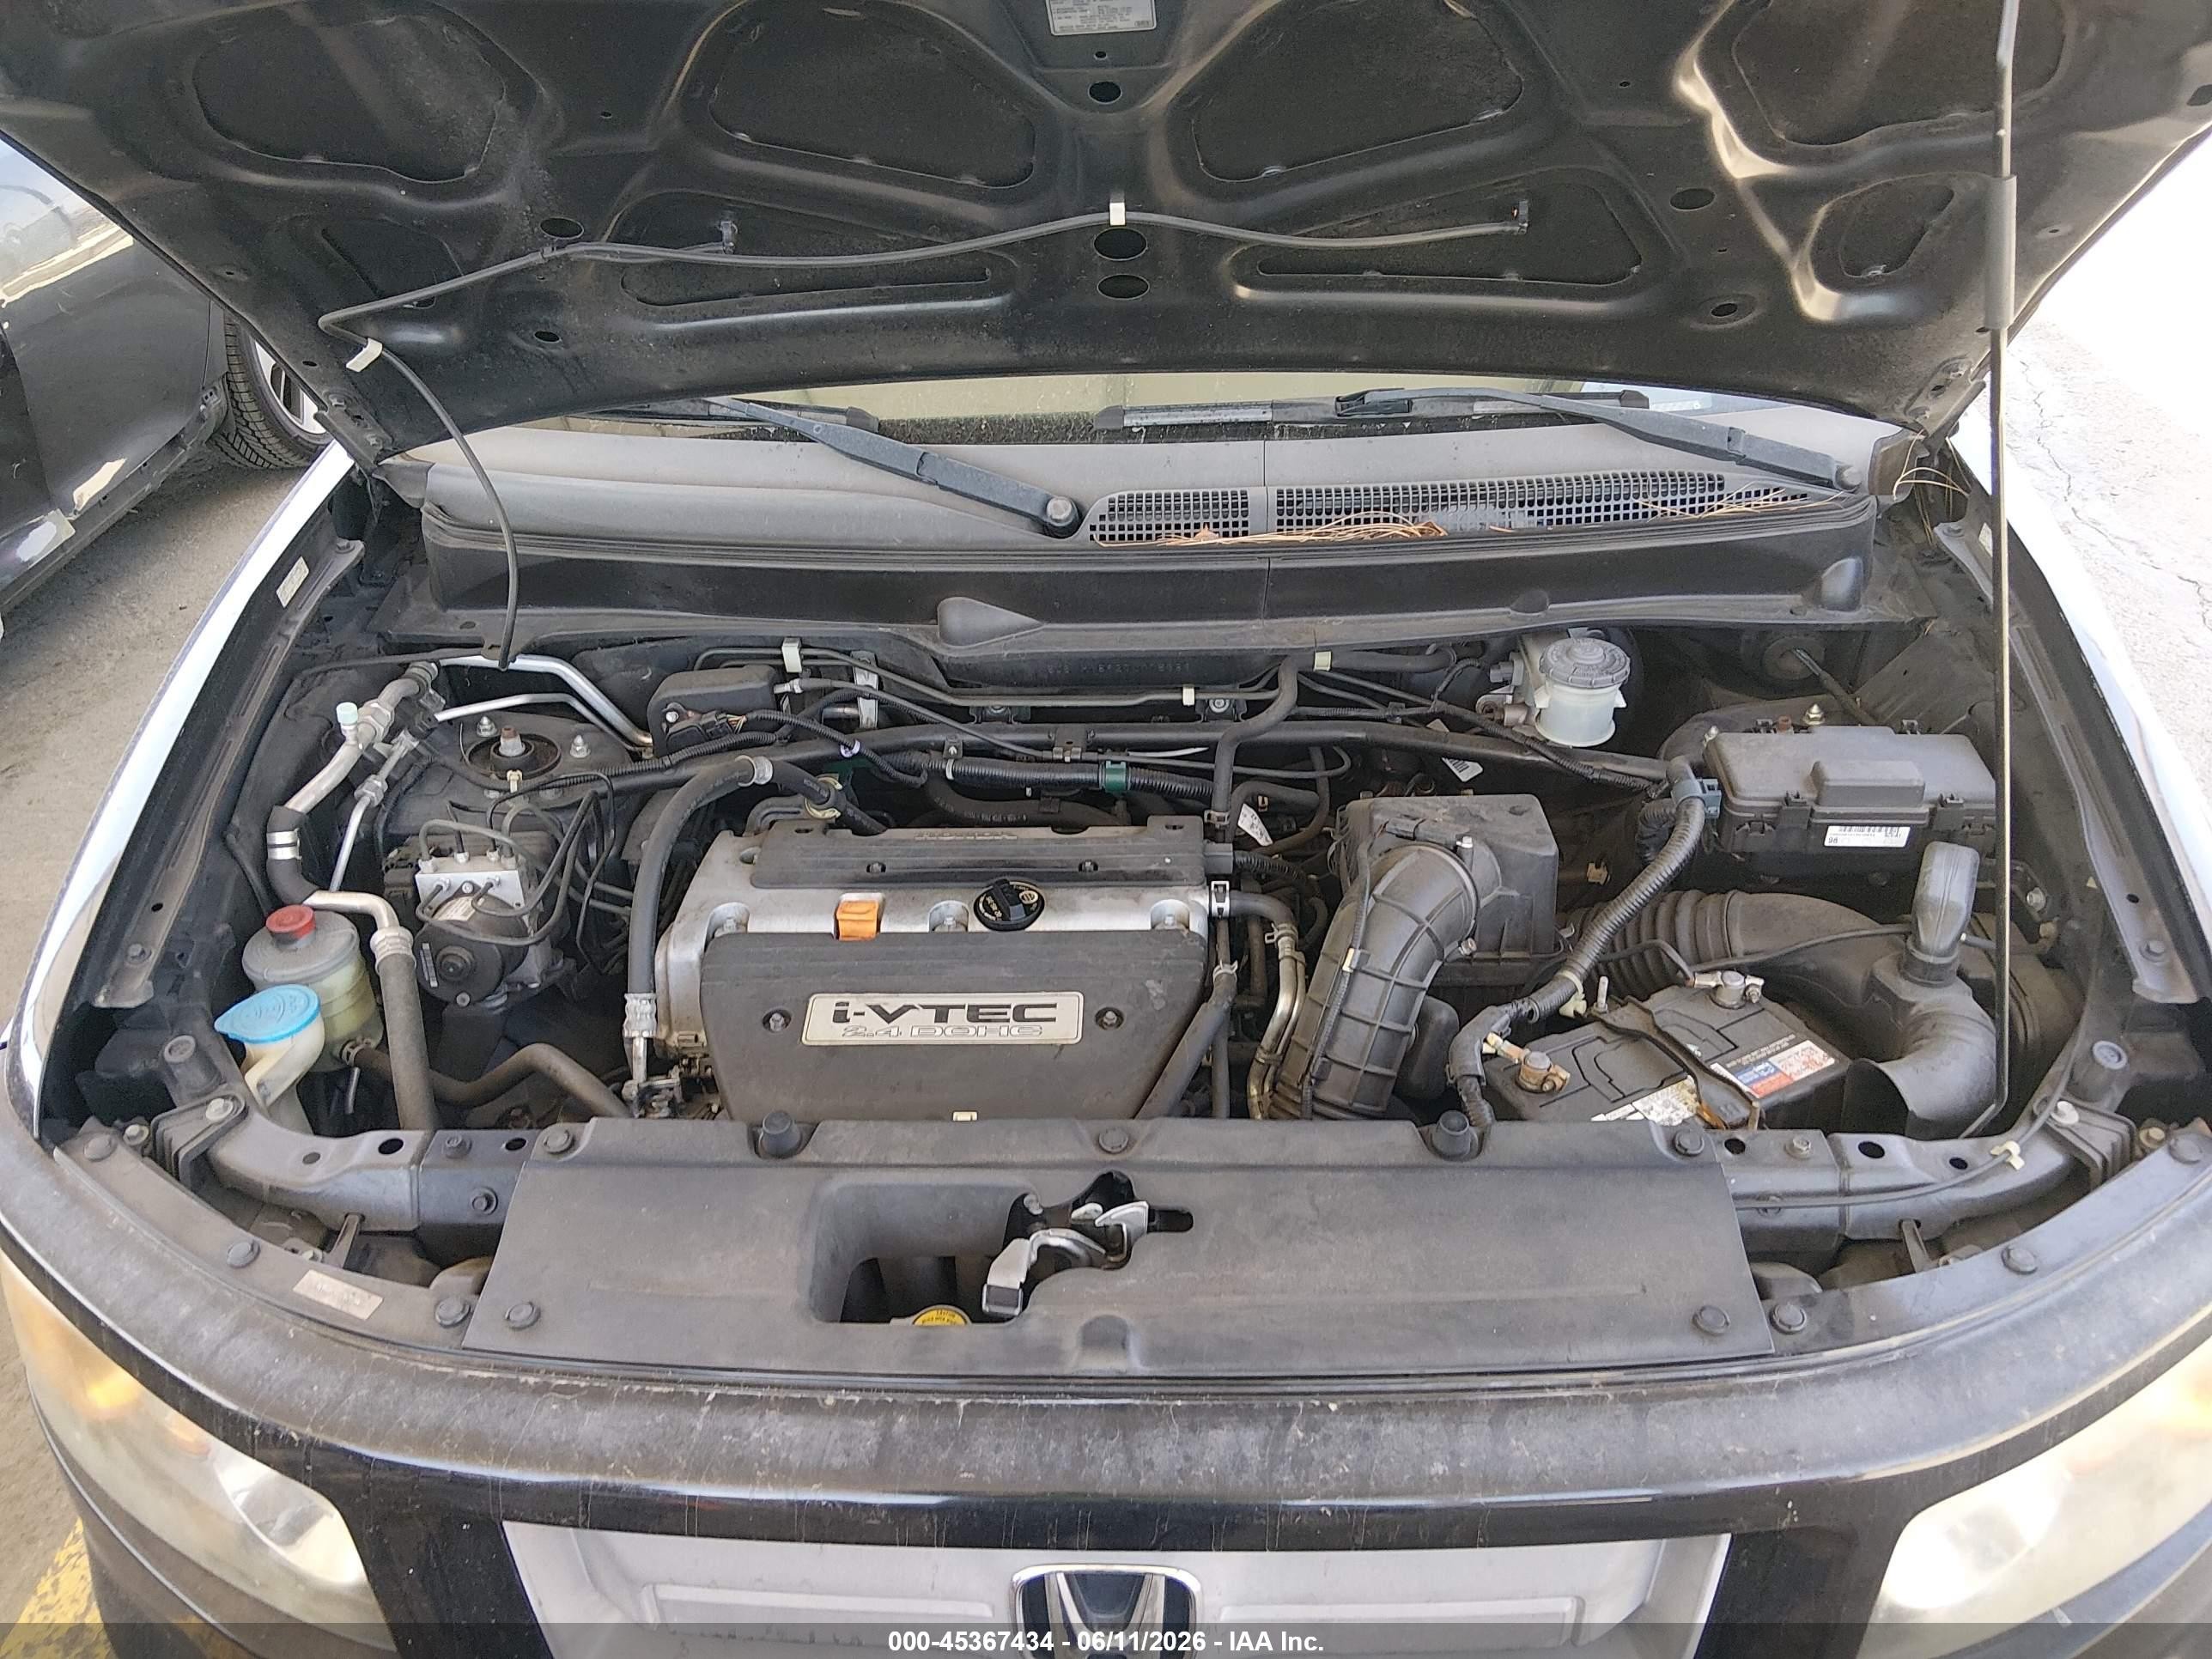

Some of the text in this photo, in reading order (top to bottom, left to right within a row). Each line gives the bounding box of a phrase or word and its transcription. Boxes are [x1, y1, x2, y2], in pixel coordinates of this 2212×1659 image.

[832, 1001, 1057, 1024] i-VTEC
[842, 1025, 1042, 1037] 2.4 DOHC
